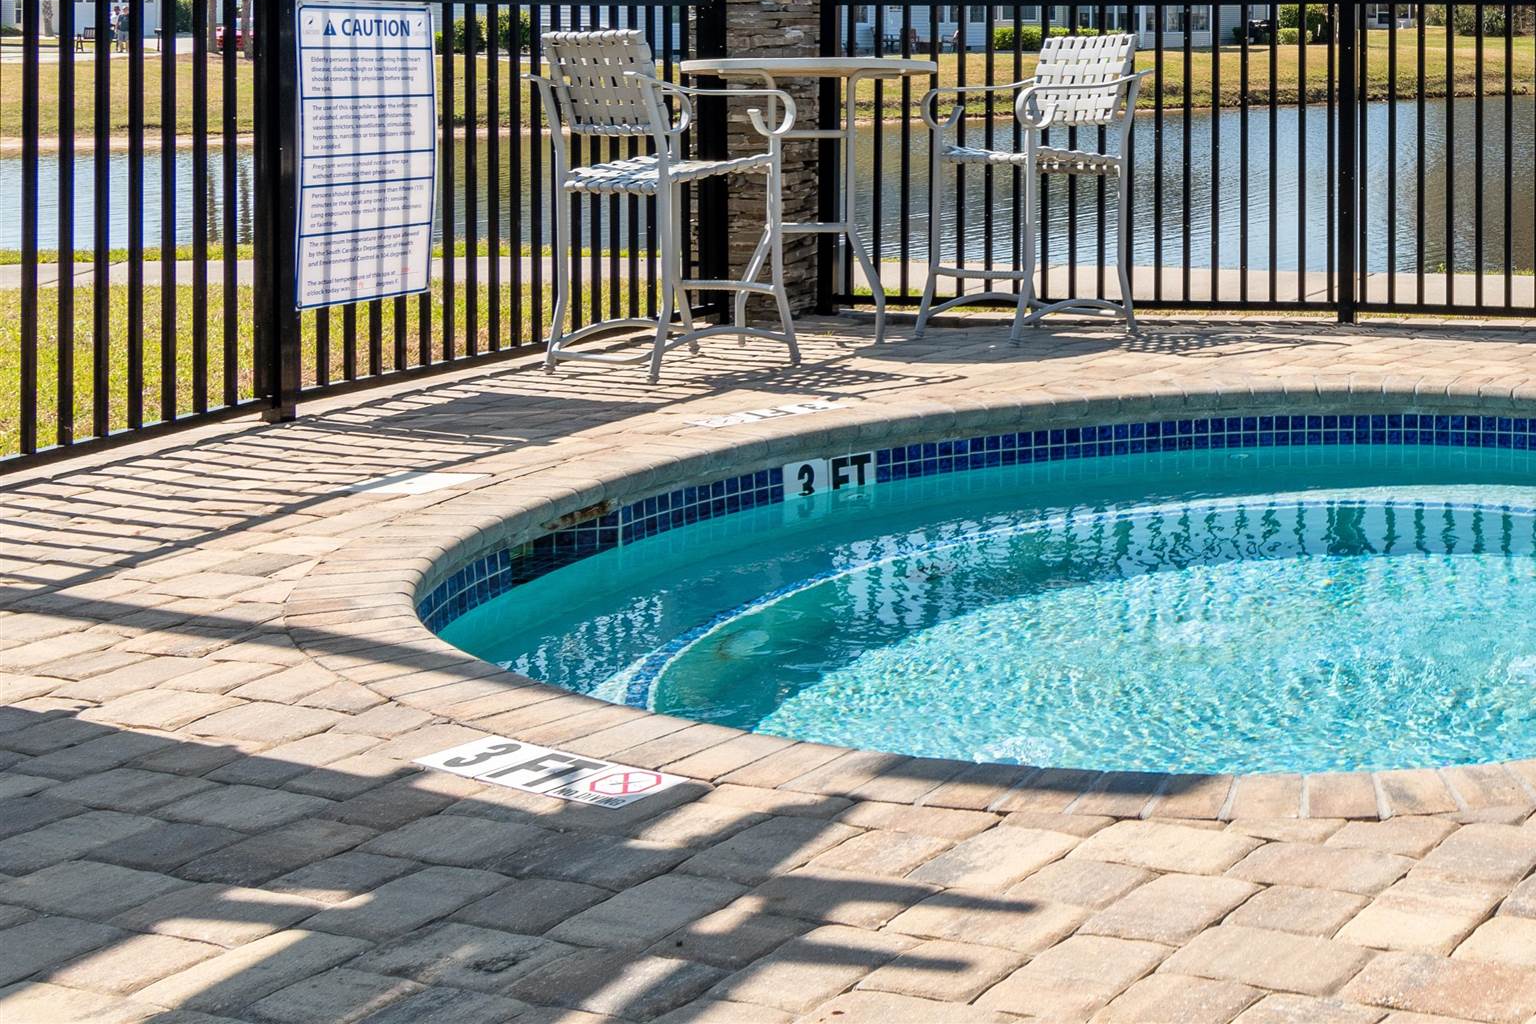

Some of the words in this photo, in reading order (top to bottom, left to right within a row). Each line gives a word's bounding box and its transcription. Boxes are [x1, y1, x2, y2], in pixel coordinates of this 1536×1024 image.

[341, 19, 411, 37] CAUTION
[797, 464, 815, 496] 3
[831, 453, 872, 490] FT
[443, 742, 522, 768] 3
[485, 752, 608, 788] FT
[554, 787, 578, 797] NO
[575, 791, 627, 807] DIVING
